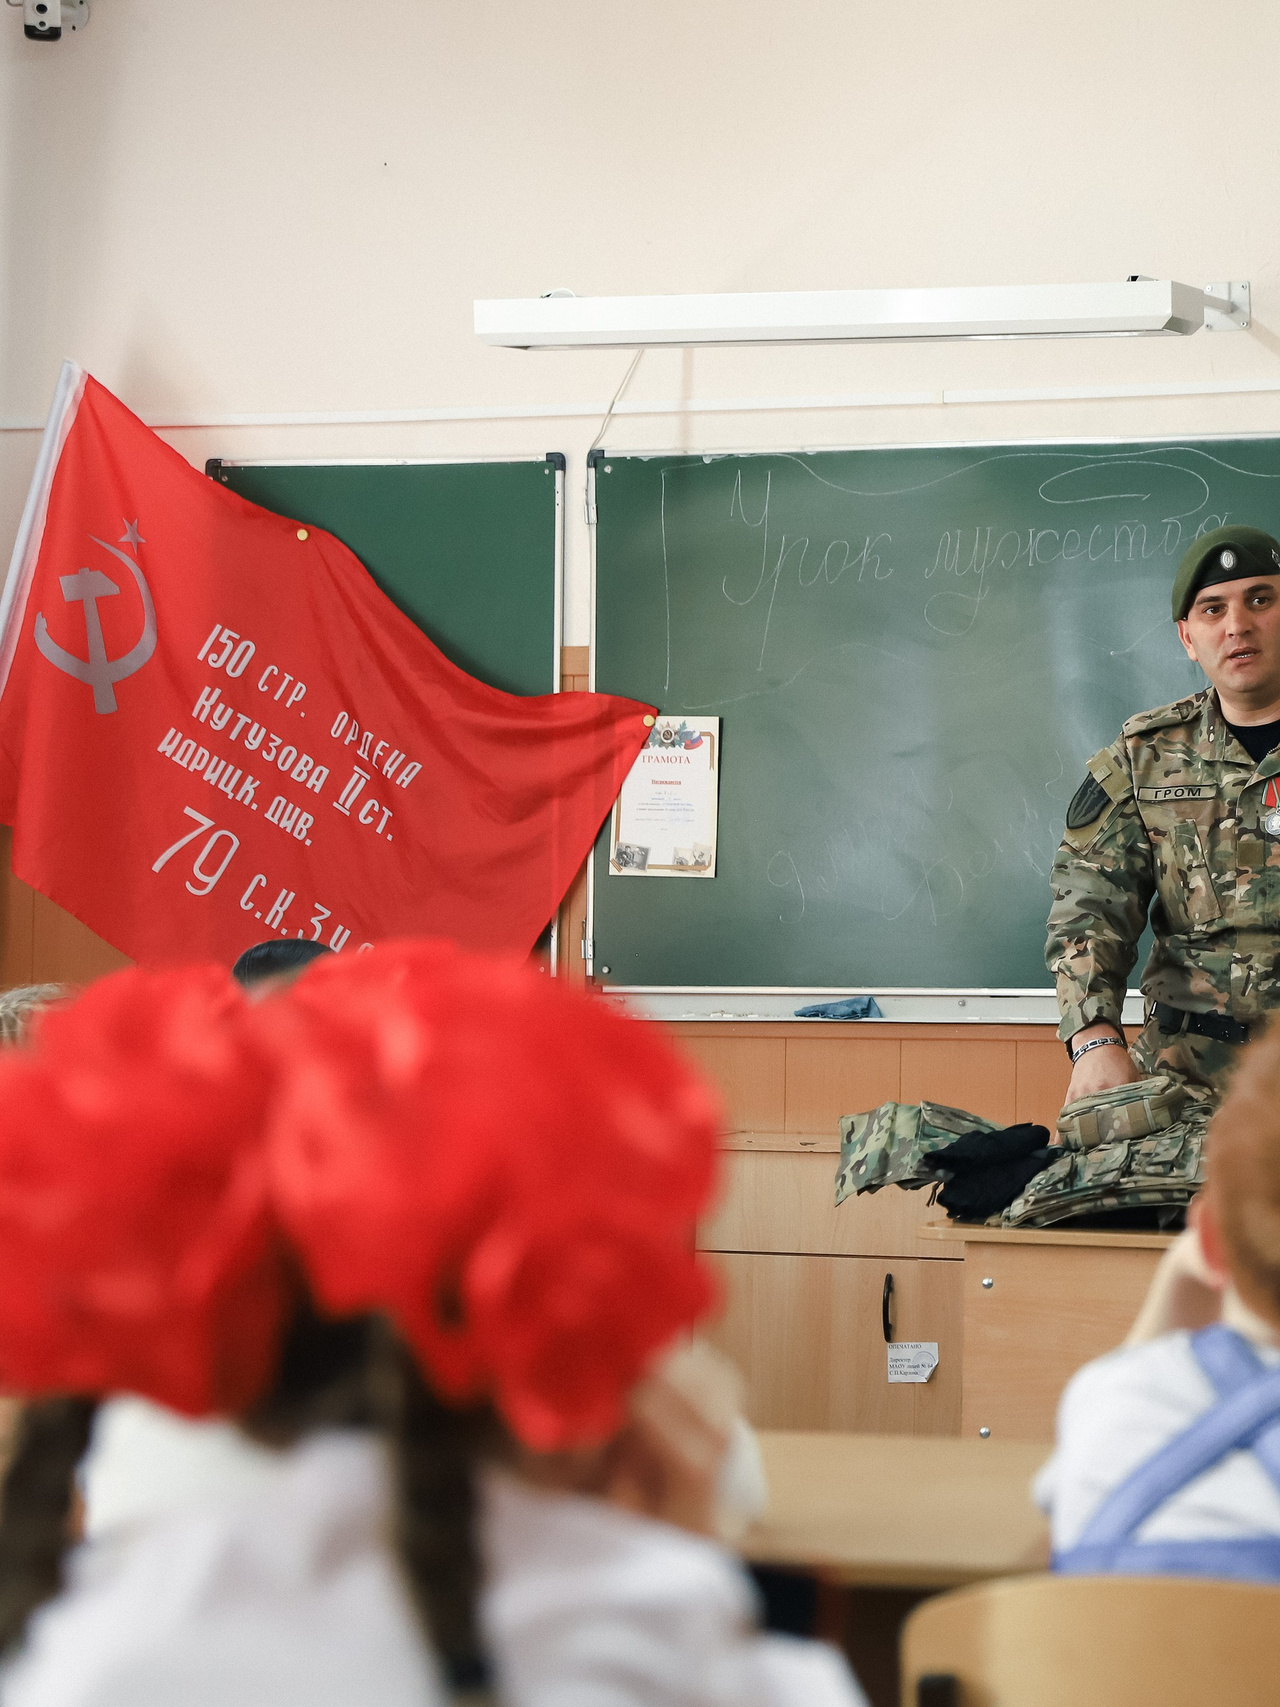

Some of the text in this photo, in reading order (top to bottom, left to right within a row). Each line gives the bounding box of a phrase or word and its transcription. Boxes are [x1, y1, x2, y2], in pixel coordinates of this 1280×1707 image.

[721, 468, 895, 672] Урок
[197, 623, 423, 789] 150 СТР. ОРДЕНА
[157, 727, 315, 847] ИДРИЦК. ДИВ.
[642, 755, 691, 765] ГРАМОТА
[1153, 787, 1202, 800] ГРОМ
[151, 805, 241, 896] 79
